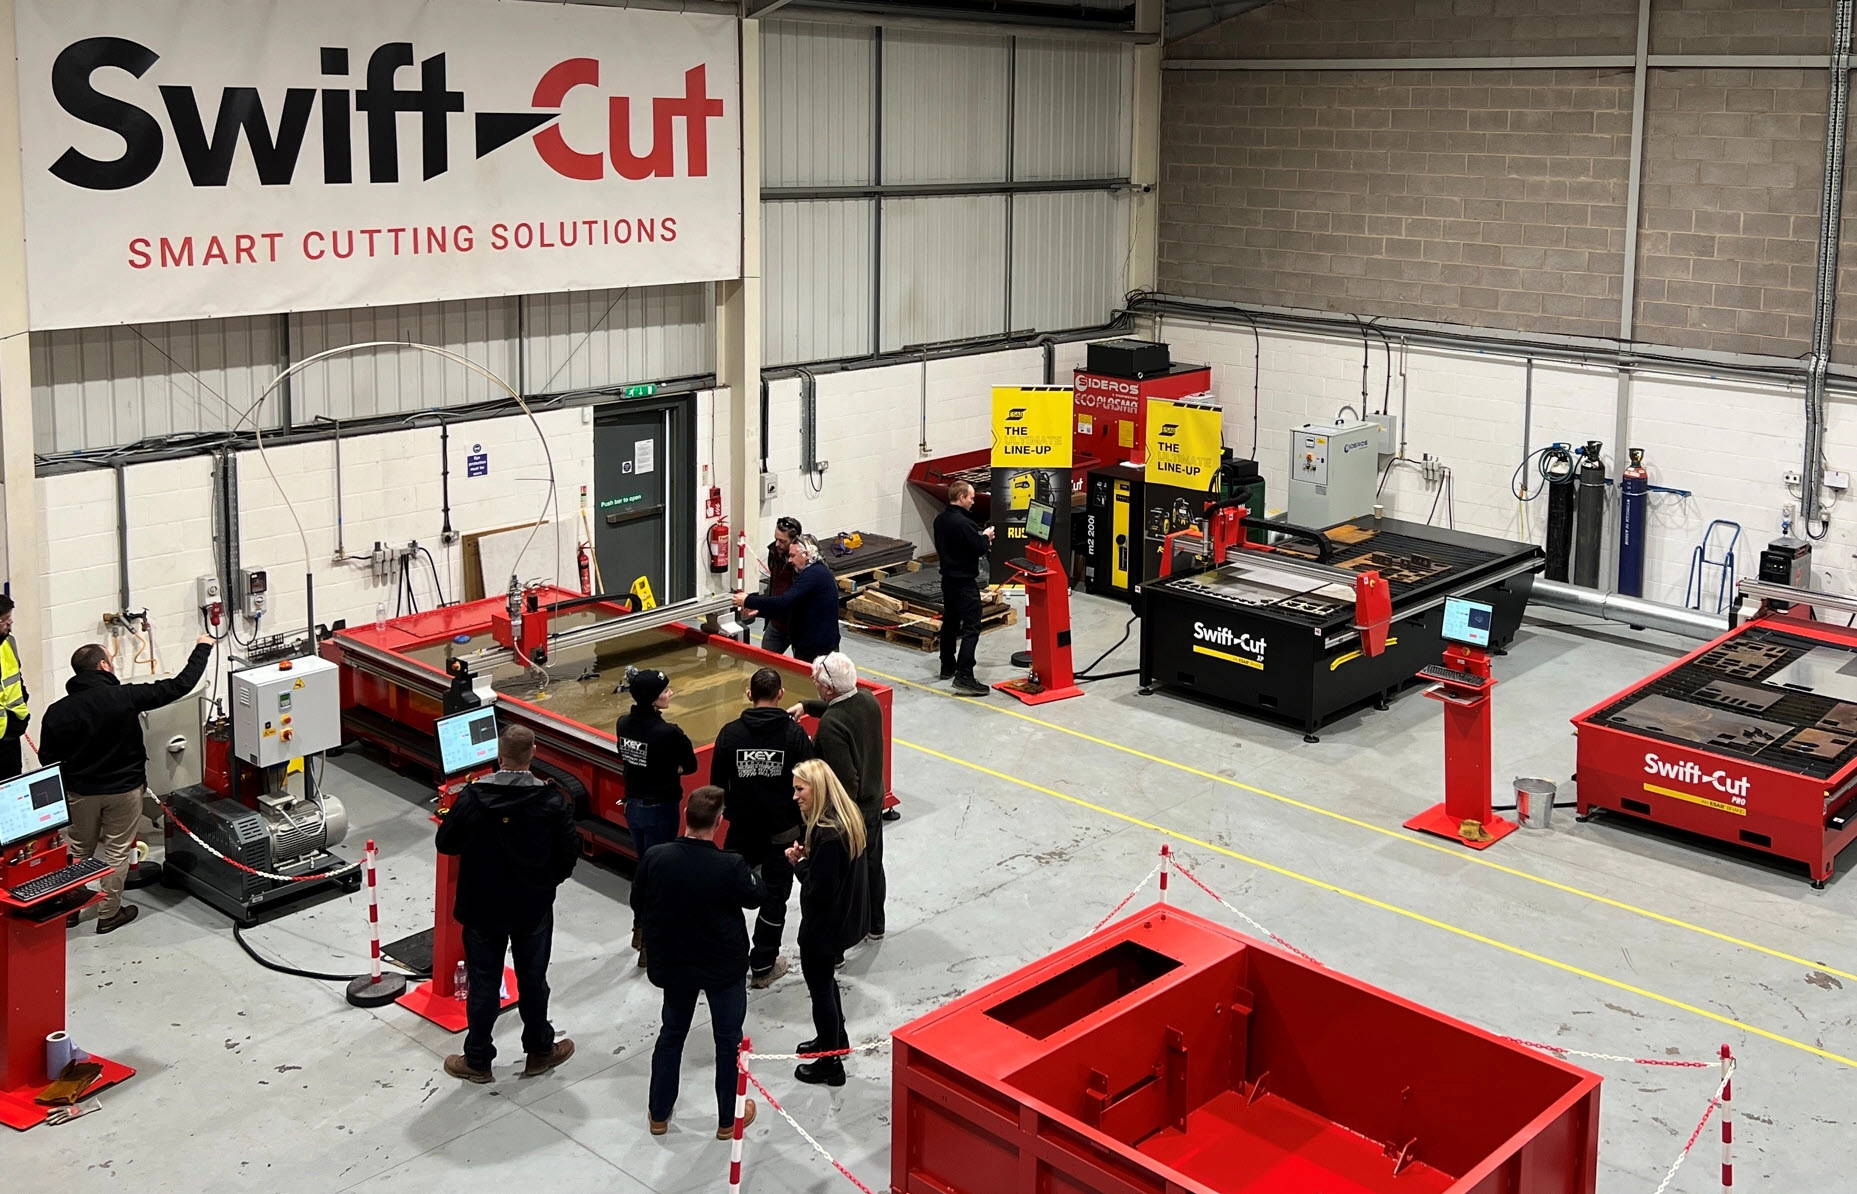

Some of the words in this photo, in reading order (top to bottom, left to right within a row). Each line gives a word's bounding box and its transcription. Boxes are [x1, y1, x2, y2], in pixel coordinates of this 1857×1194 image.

[128, 232, 285, 270] SMART
[303, 224, 475, 261] CUTTING
[490, 216, 679, 251] SOLUTIONS
[1075, 375, 1139, 395] SIDEROS
[1004, 426, 1028, 436] THE
[1004, 436, 1062, 446] ULTIMATE
[1157, 441, 1180, 453] THE
[1004, 446, 1052, 455] LINE-UP
[1157, 451, 1212, 468] ULTIMATE
[1157, 461, 1201, 476] LINE-UP
[600, 500, 614, 508] Push
[629, 494, 642, 502] open
[623, 738, 642, 751] KEY
[743, 751, 777, 761] KEY
[1731, 796, 1747, 806] PRO
